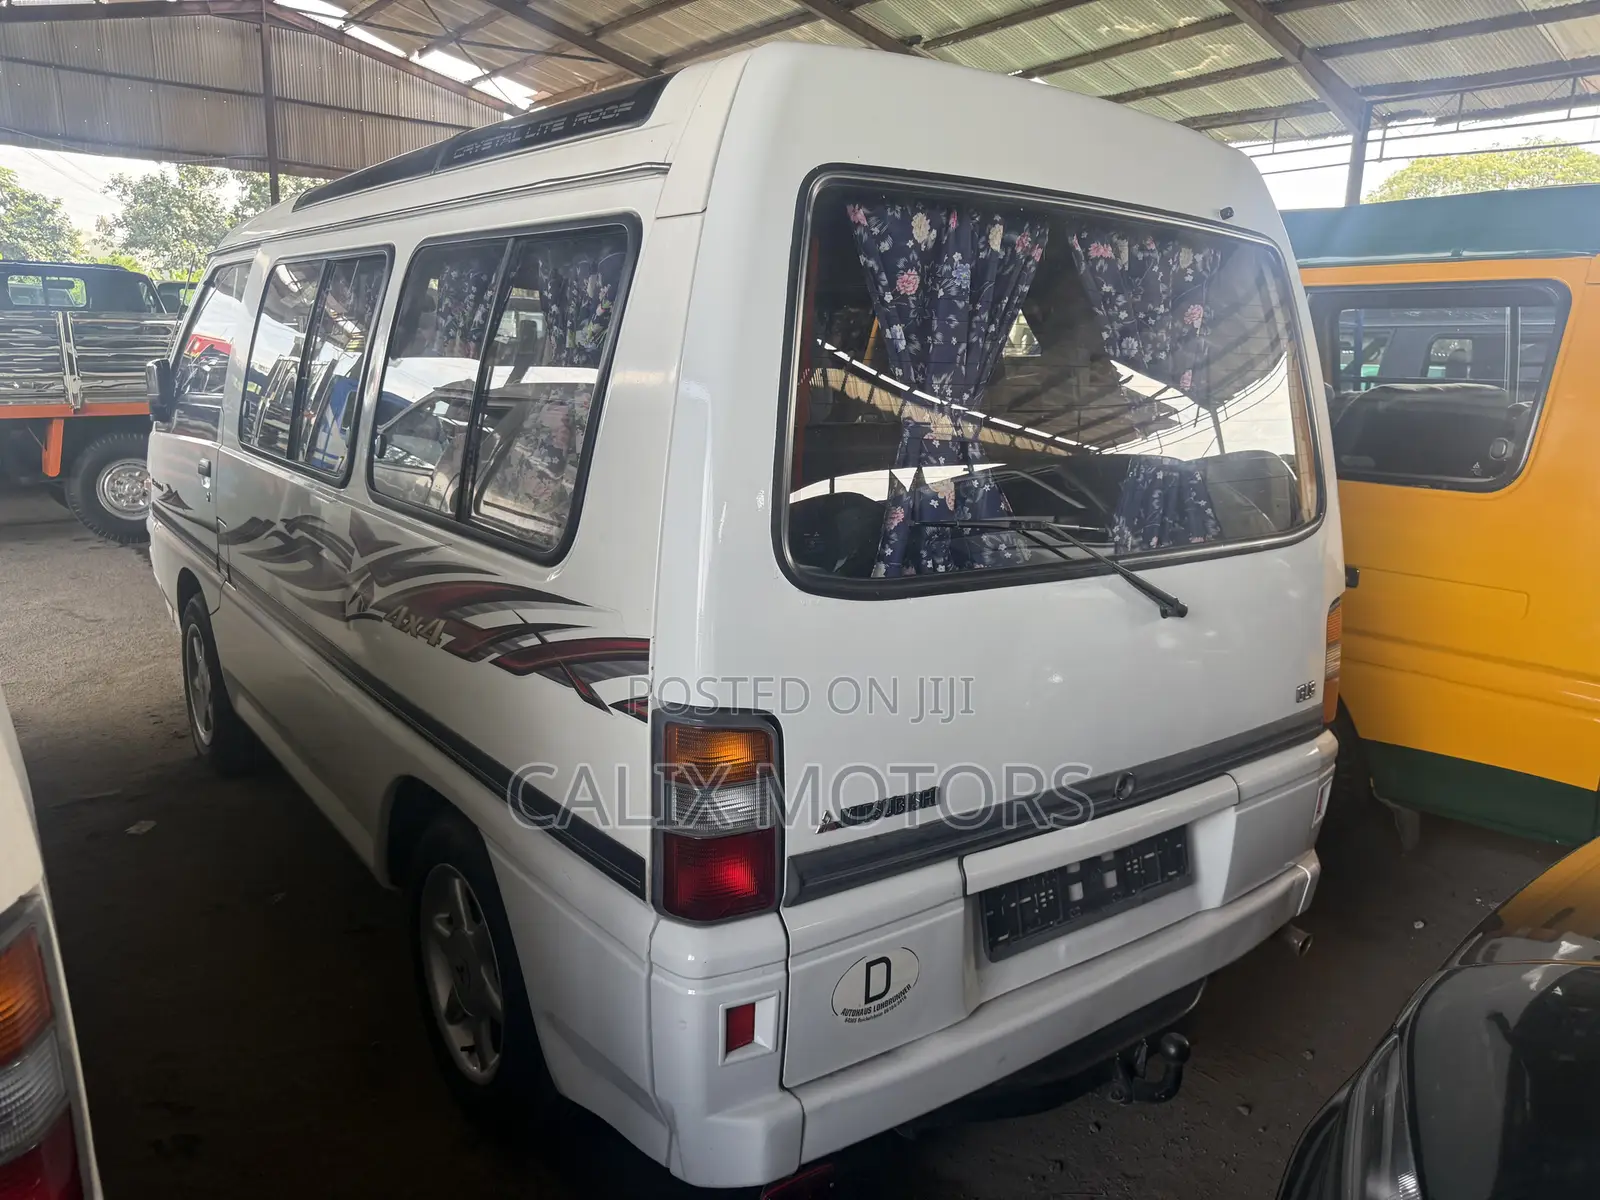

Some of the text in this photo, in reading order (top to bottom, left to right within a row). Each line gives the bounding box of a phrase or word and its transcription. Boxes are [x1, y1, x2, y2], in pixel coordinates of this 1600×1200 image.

[453, 101, 635, 159] CRYSTAL LITE ROOF
[383, 604, 448, 647] 4x4
[841, 983, 912, 1017] AUTOHAUS LOHBRUNNER
[865, 956, 892, 1004] D
